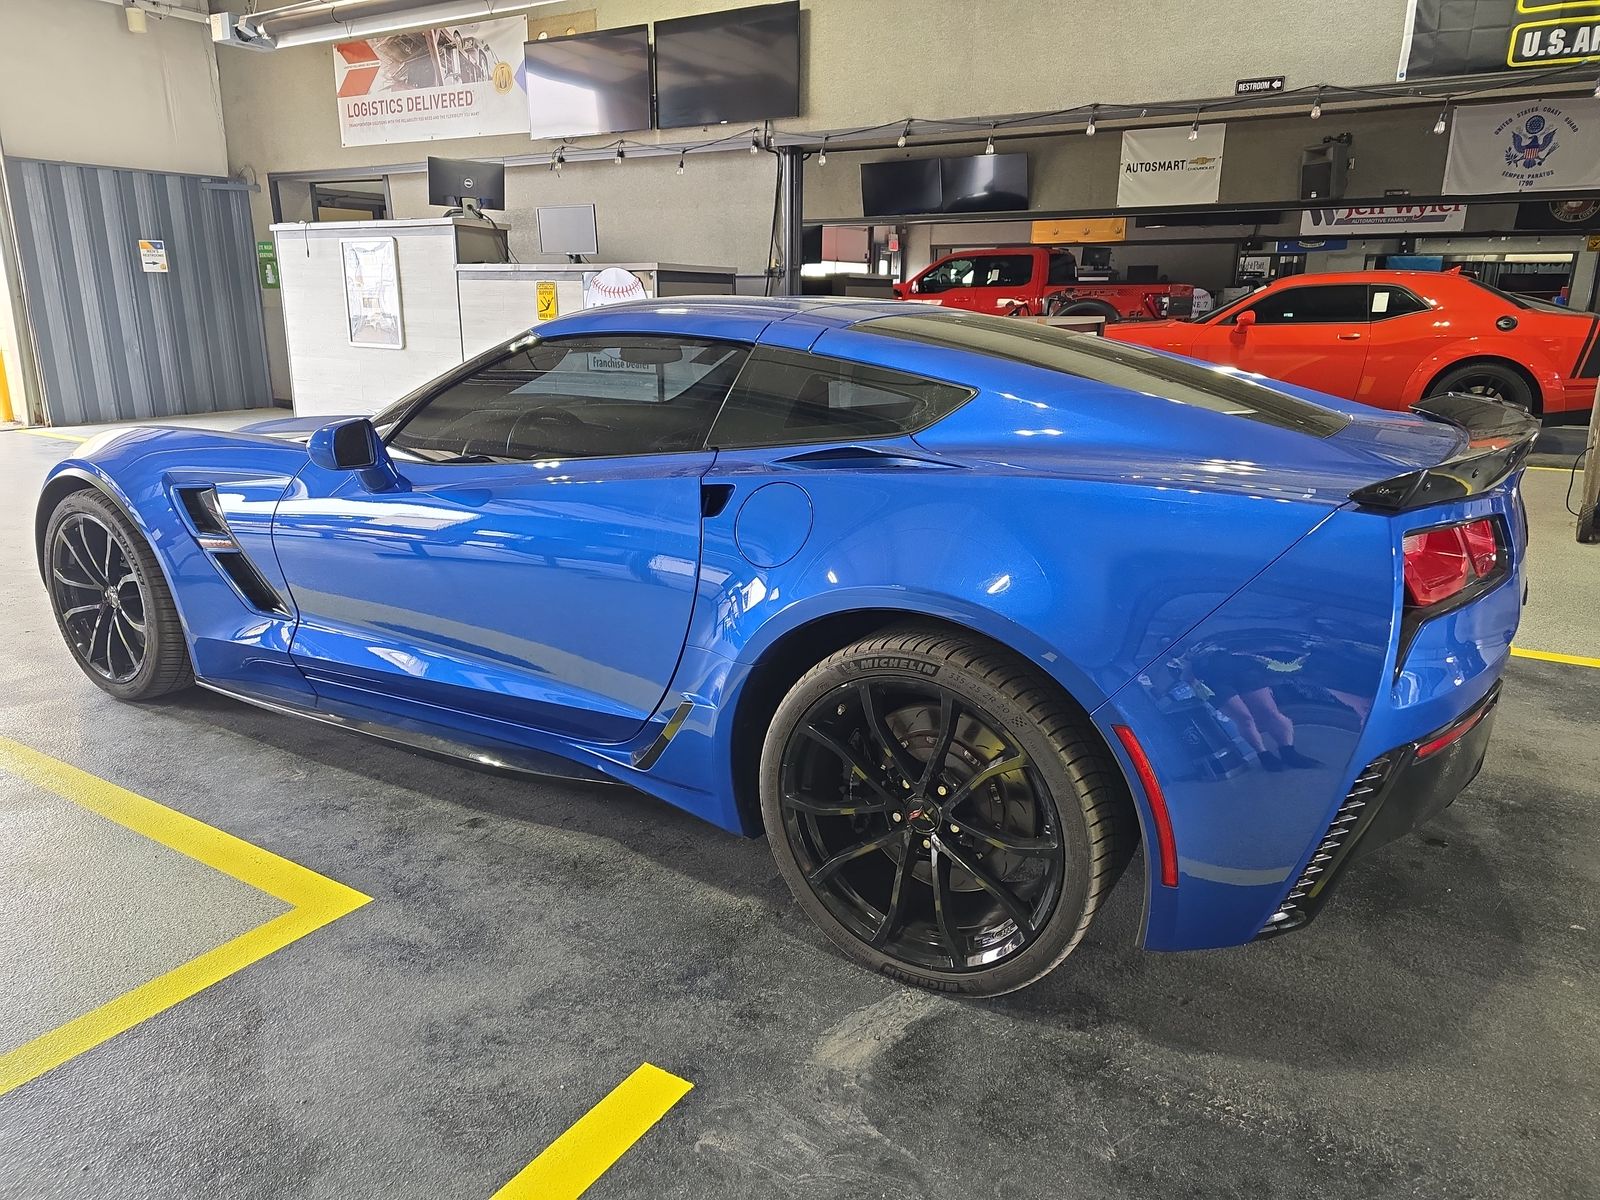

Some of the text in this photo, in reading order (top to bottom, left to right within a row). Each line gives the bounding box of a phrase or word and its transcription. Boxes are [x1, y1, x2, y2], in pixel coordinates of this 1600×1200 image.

[1238, 81, 1270, 91] RESTROOM
[347, 90, 473, 118] LOGISTICS DELIVERED
[1494, 106, 1579, 135] UNITED STATES COAST GUARD
[1125, 160, 1186, 173] AUTOSMART
[1501, 169, 1554, 179] SEMPER PARATUS
[593, 356, 625, 369] Franchise
[860, 658, 936, 675] MICHELIN
